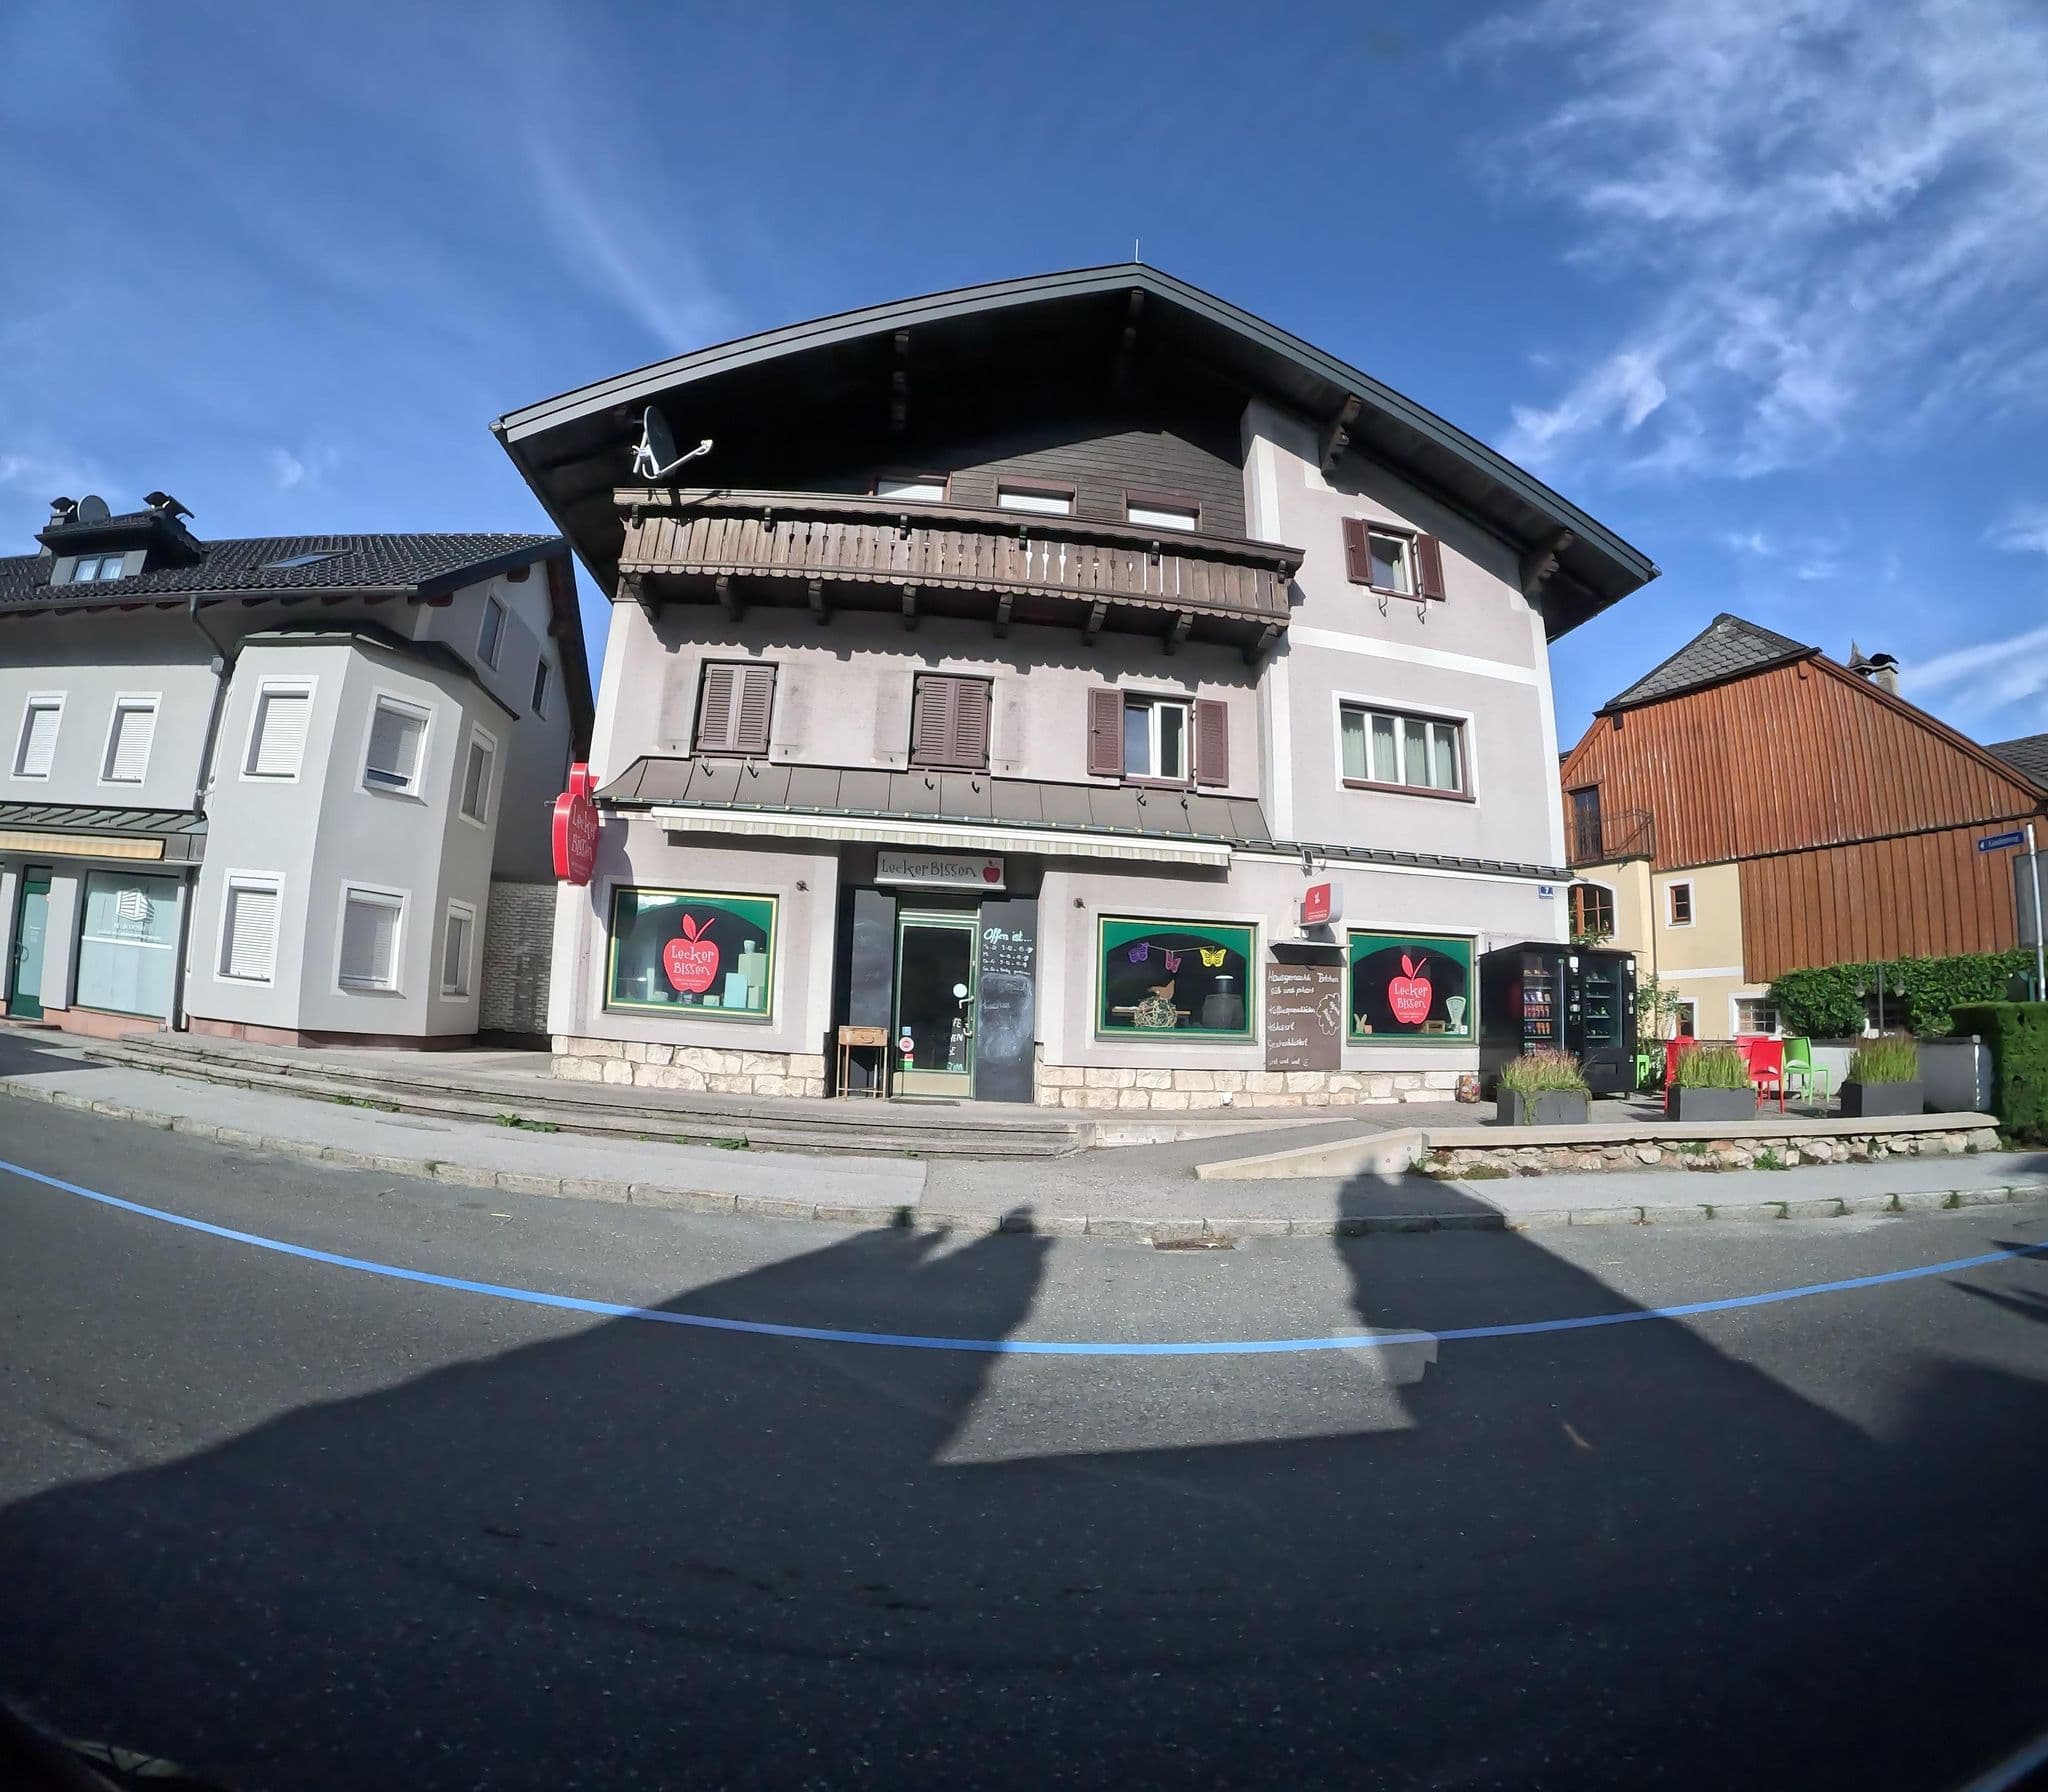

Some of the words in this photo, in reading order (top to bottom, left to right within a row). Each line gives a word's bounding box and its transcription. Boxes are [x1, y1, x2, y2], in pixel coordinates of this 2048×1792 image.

[983, 927, 1009, 944] Offen
[671, 945, 714, 963] Lecker
[1394, 983, 1428, 998] Lecker
